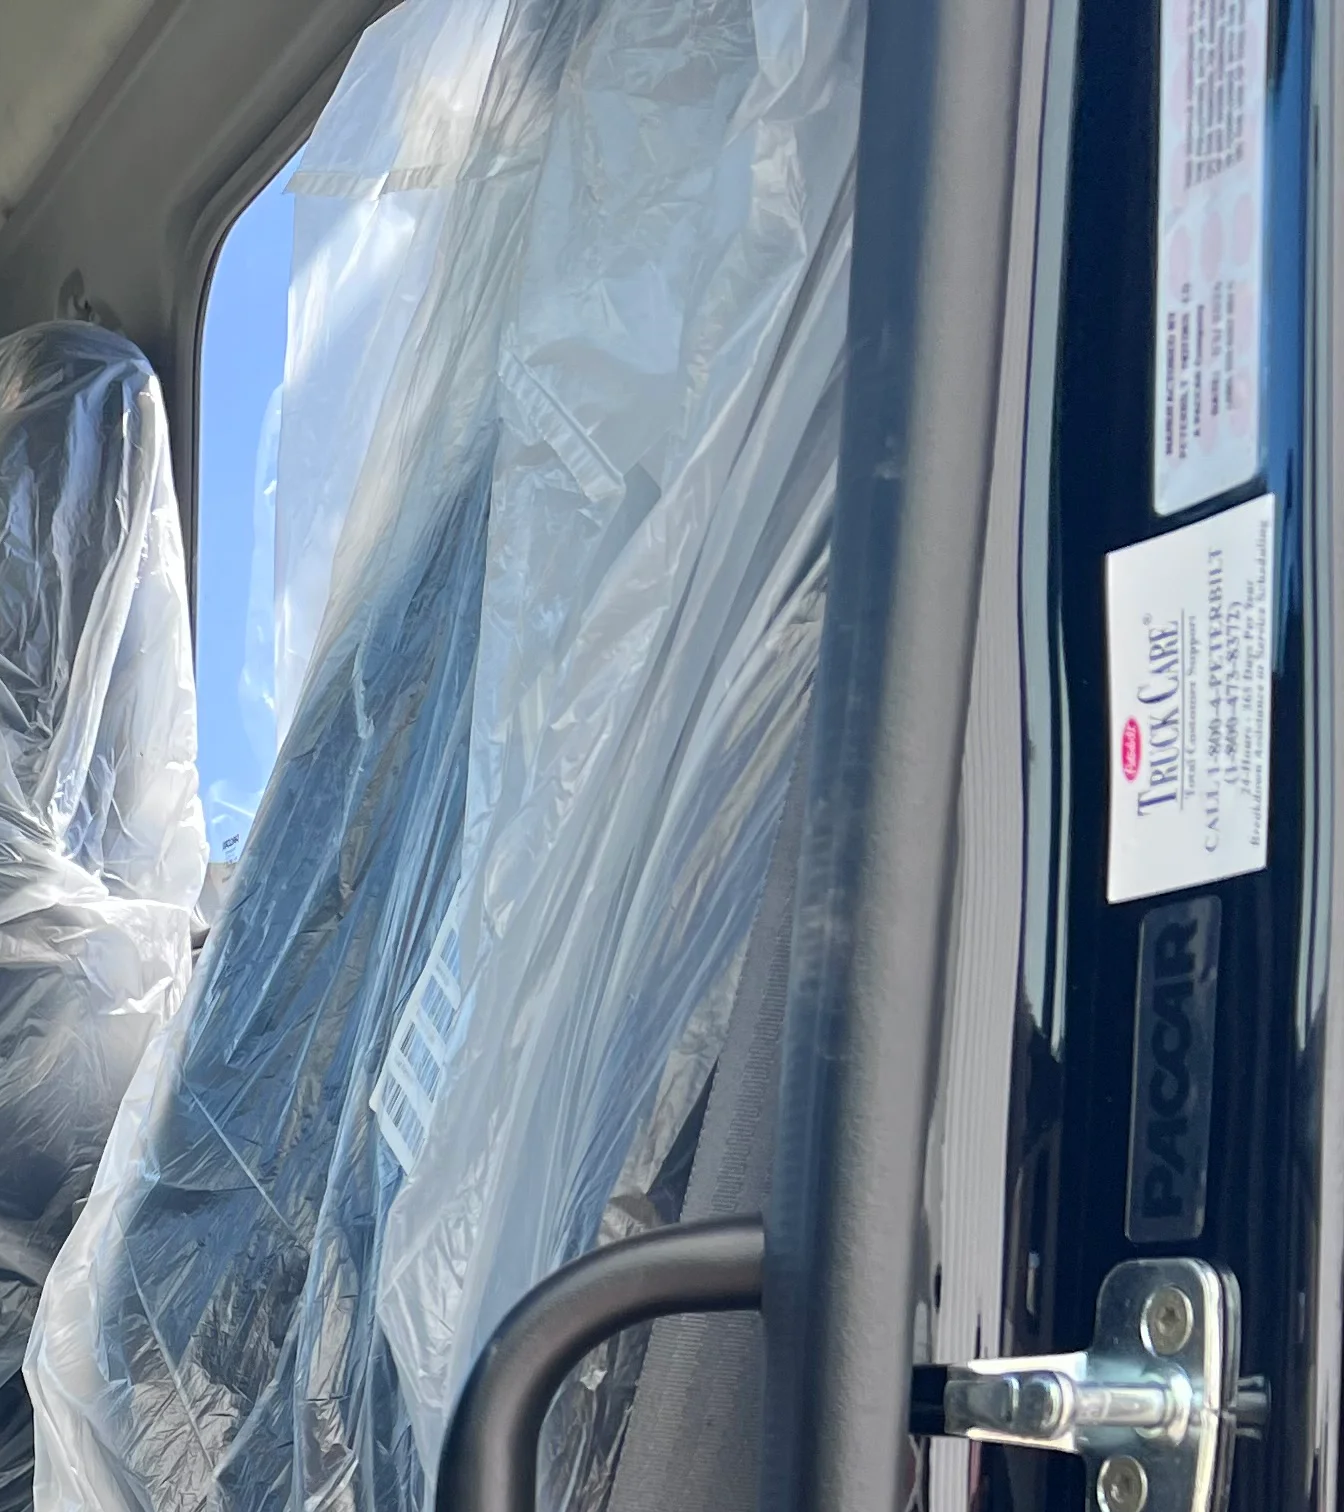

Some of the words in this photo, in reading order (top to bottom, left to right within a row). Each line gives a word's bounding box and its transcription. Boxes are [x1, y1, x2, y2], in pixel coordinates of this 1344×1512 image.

[1137, 706, 1180, 816] TRUCK
[1205, 780, 1220, 853] CALL
[1141, 917, 1199, 1219] PACCAR
